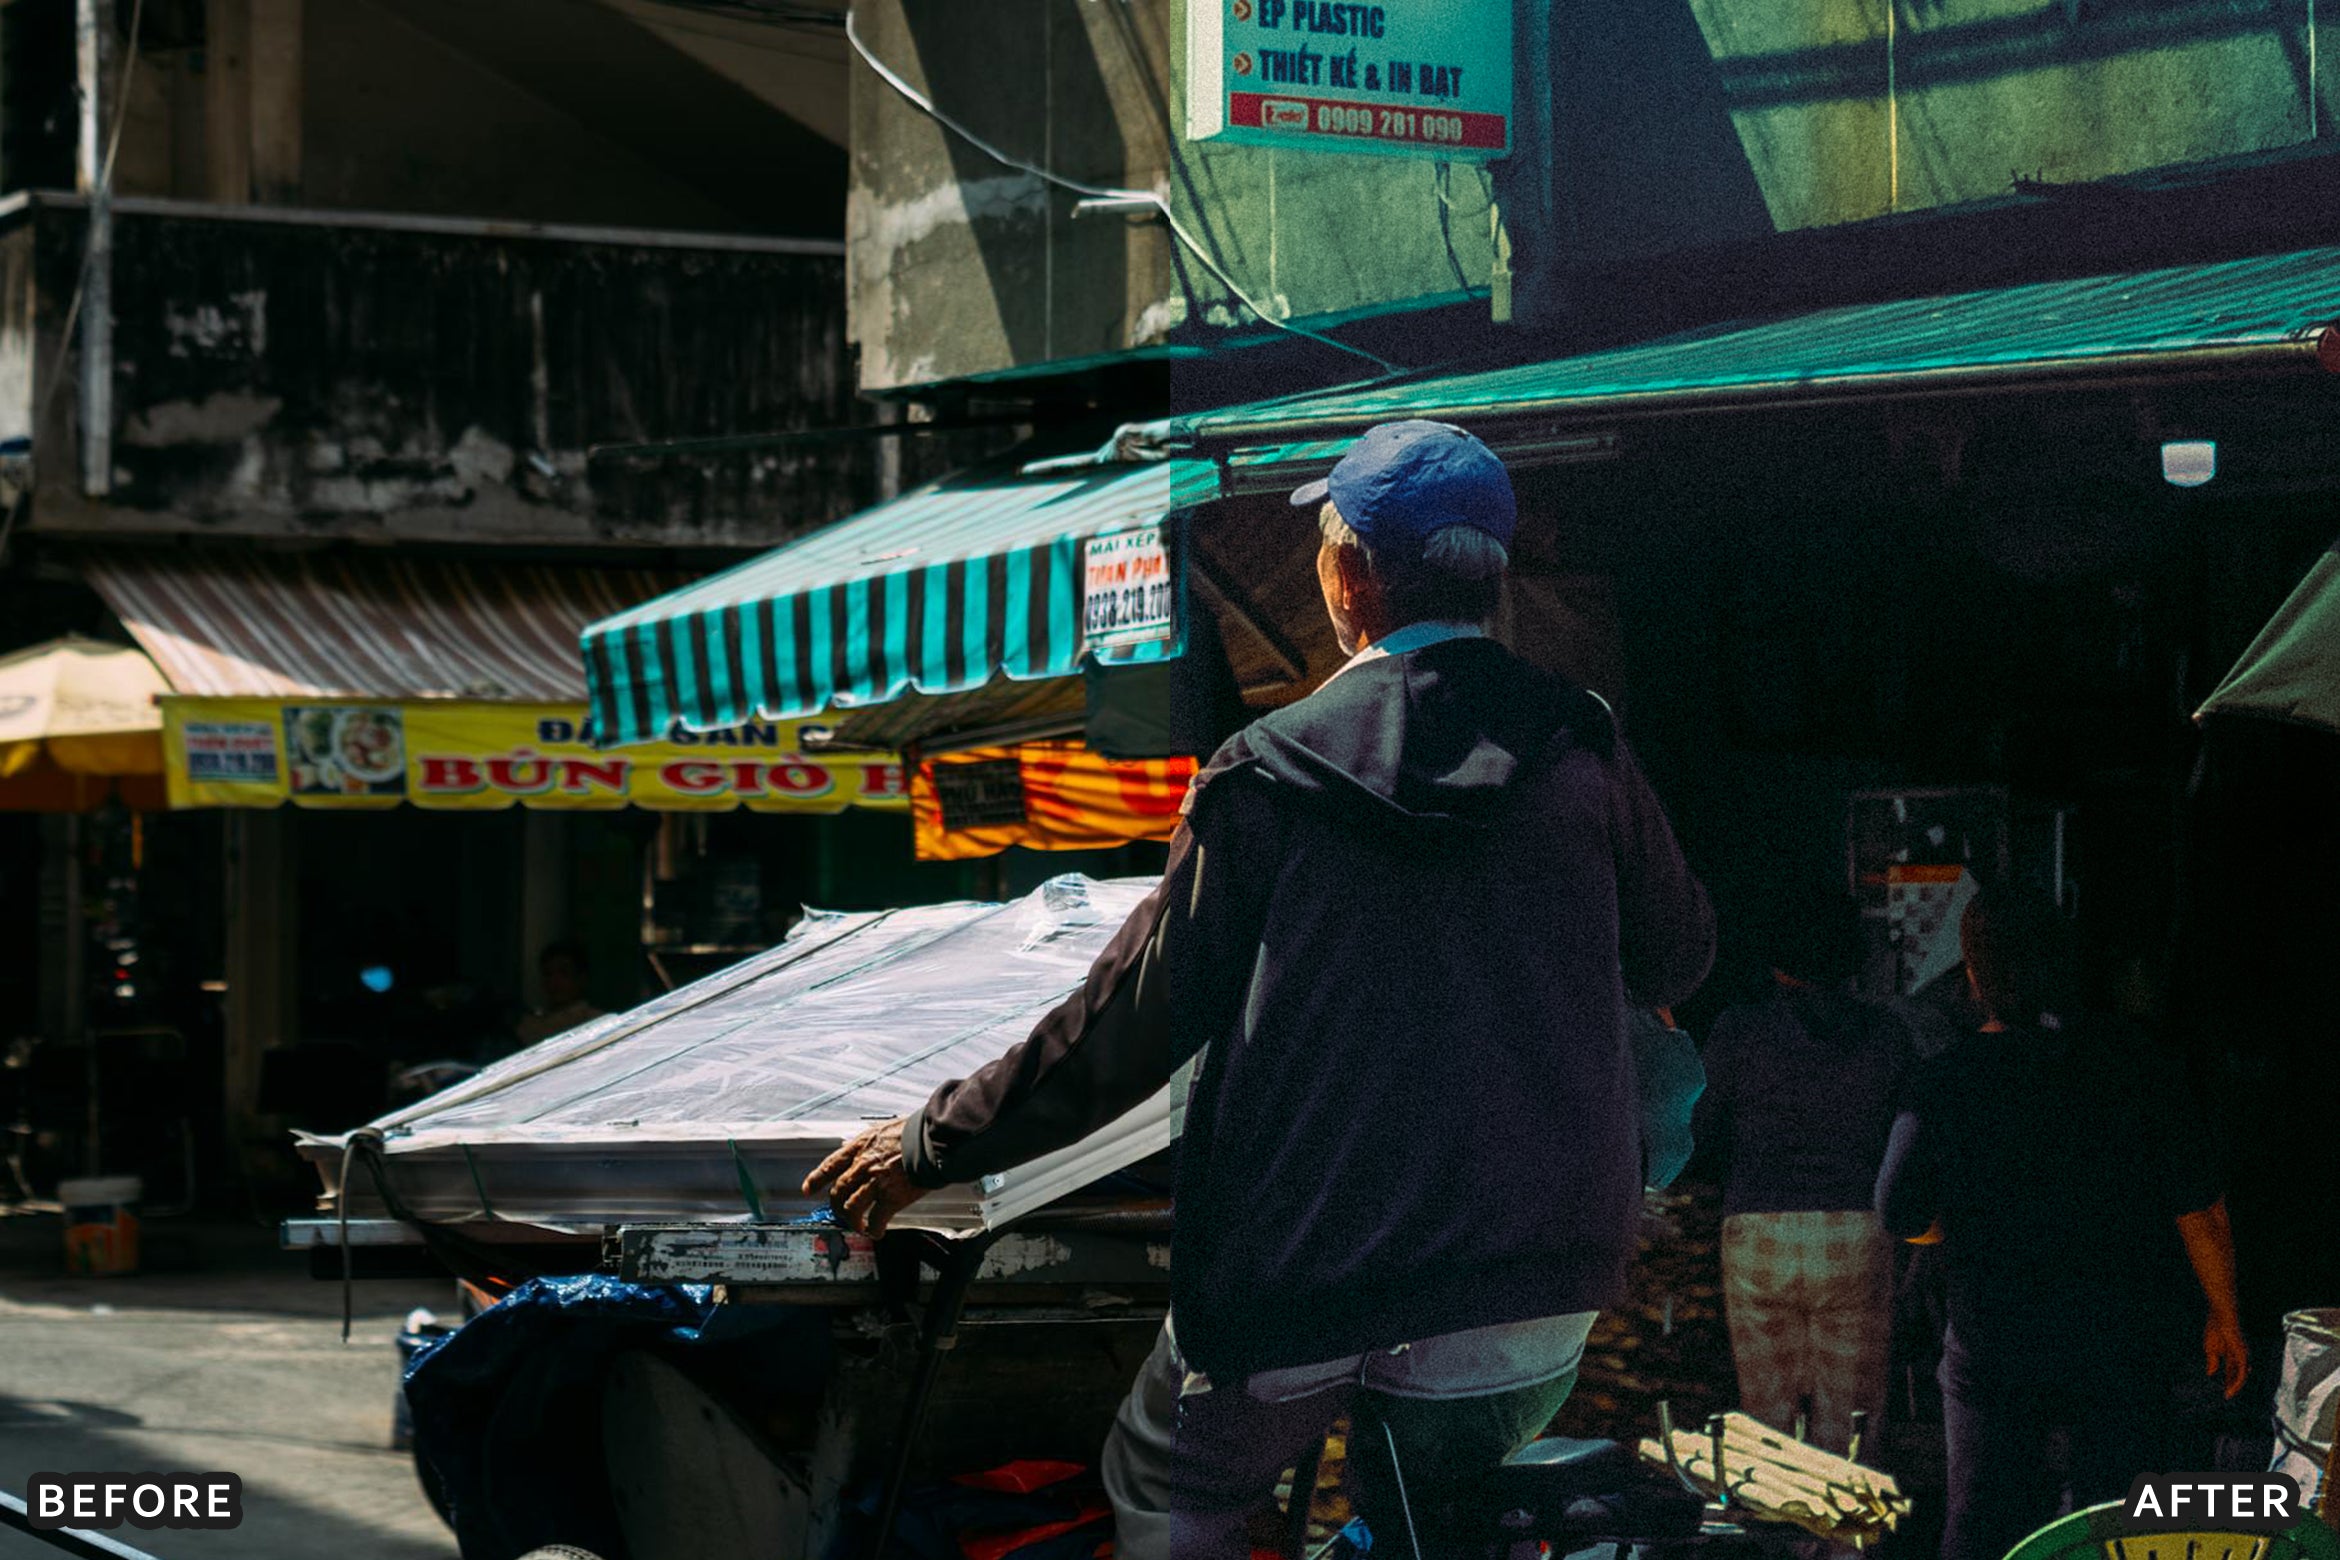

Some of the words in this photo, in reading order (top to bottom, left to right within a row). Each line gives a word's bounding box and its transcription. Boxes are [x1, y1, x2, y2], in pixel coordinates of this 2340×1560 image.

[1293, 0, 1385, 38] PLASTIC
[1365, 64, 1380, 91] &
[1389, 62, 1411, 93] IN
[1317, 104, 1373, 135] 0909
[420, 748, 629, 793] BÚN
[660, 752, 833, 795] GIÒ
